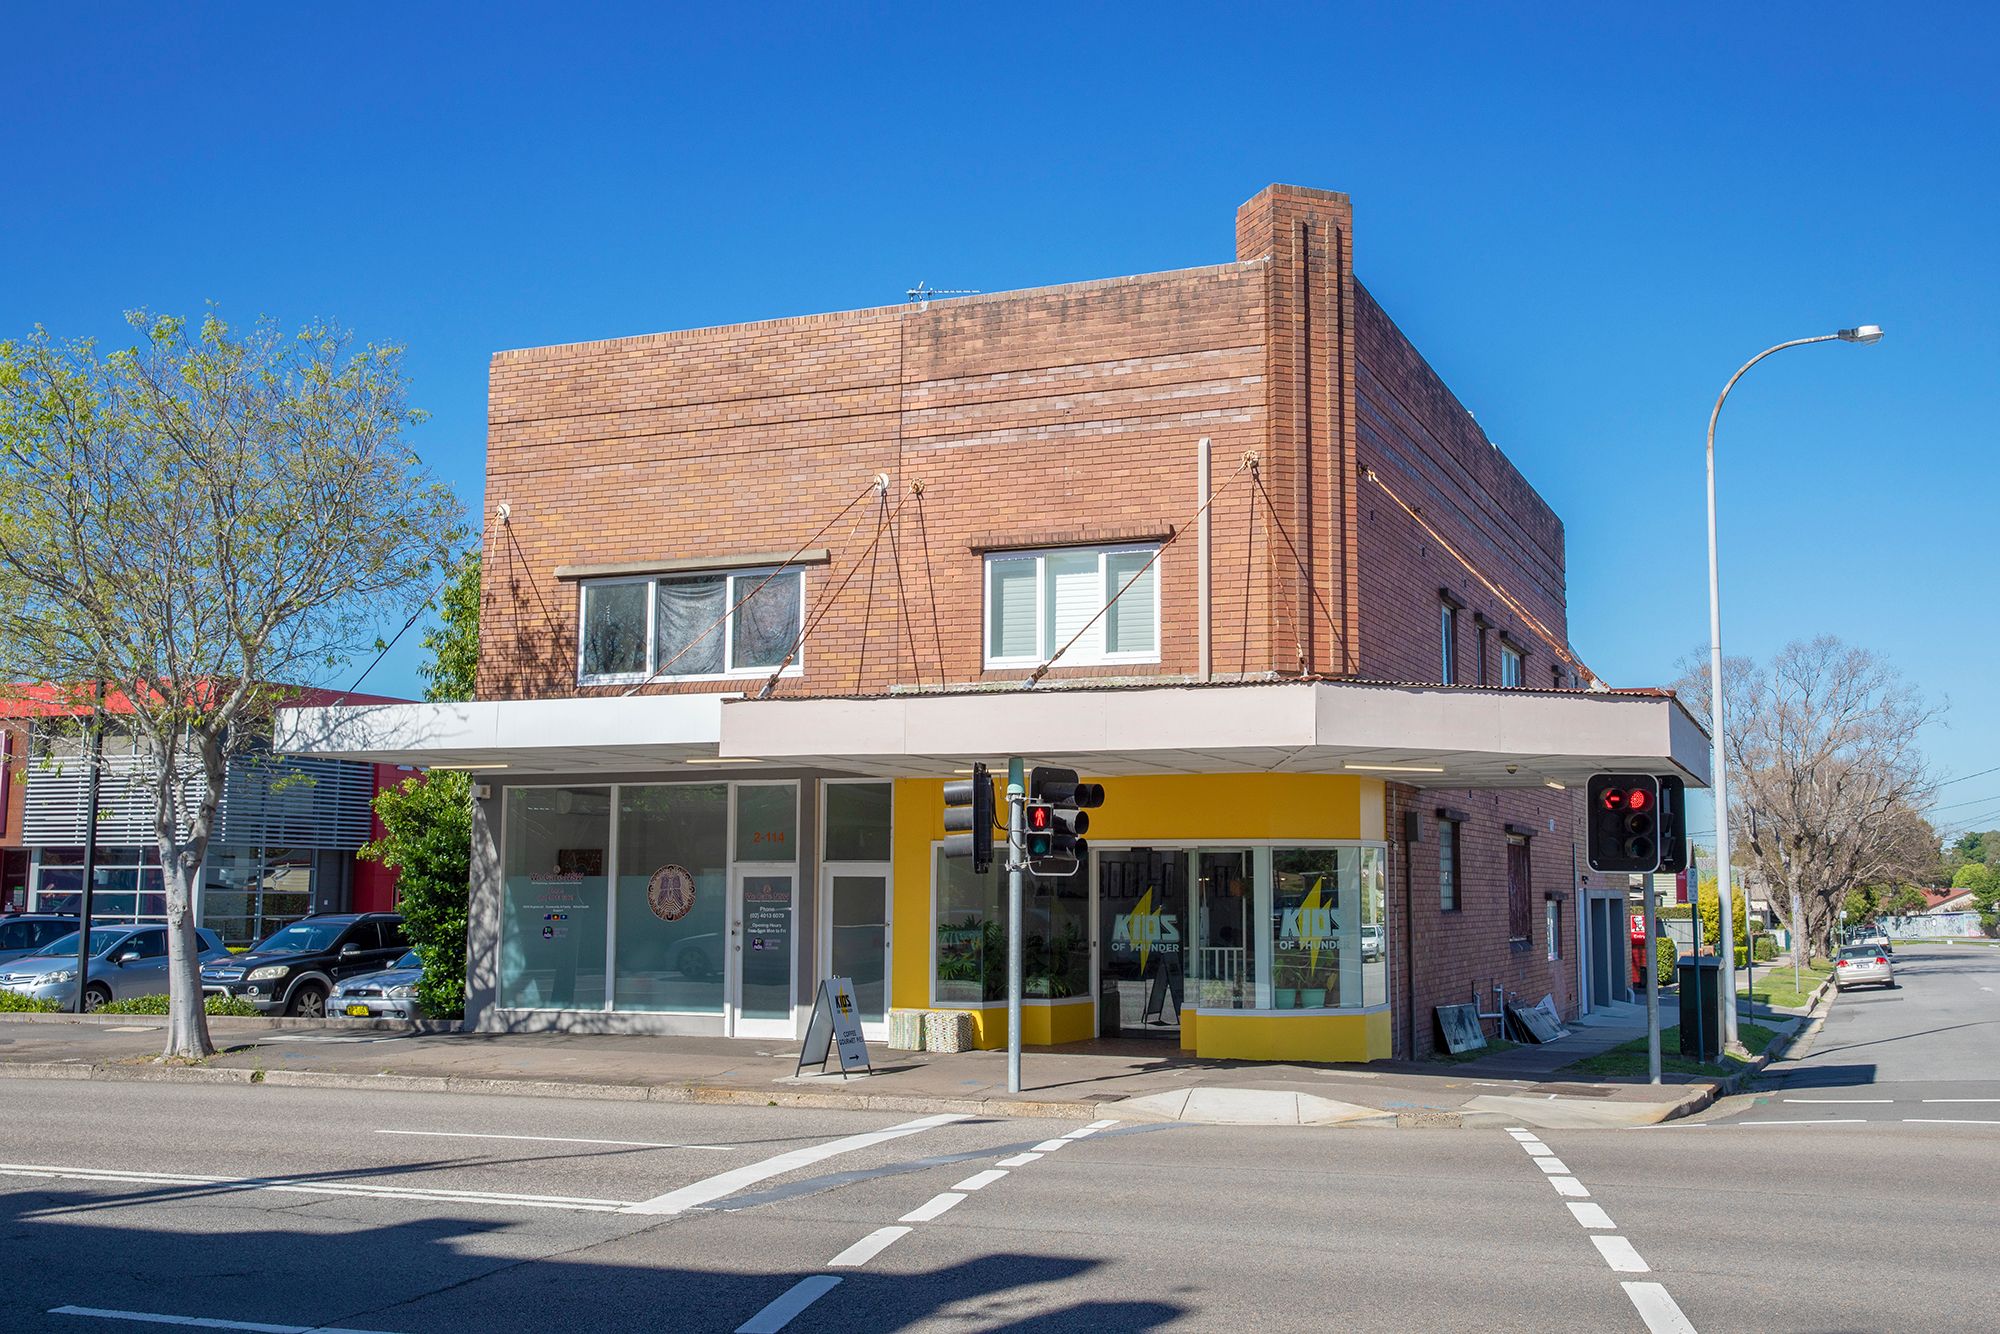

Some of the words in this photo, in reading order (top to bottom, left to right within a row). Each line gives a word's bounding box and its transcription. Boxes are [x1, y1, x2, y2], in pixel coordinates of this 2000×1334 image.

[1112, 914, 1180, 942] KIDS
[1280, 908, 1345, 938] KIDS
[1111, 943, 1126, 951] OF
[1128, 943, 1180, 952] THUNDER
[1280, 940, 1295, 950] OF
[835, 995, 852, 1008] KIDS
[843, 1030, 857, 1038] COFFEE
